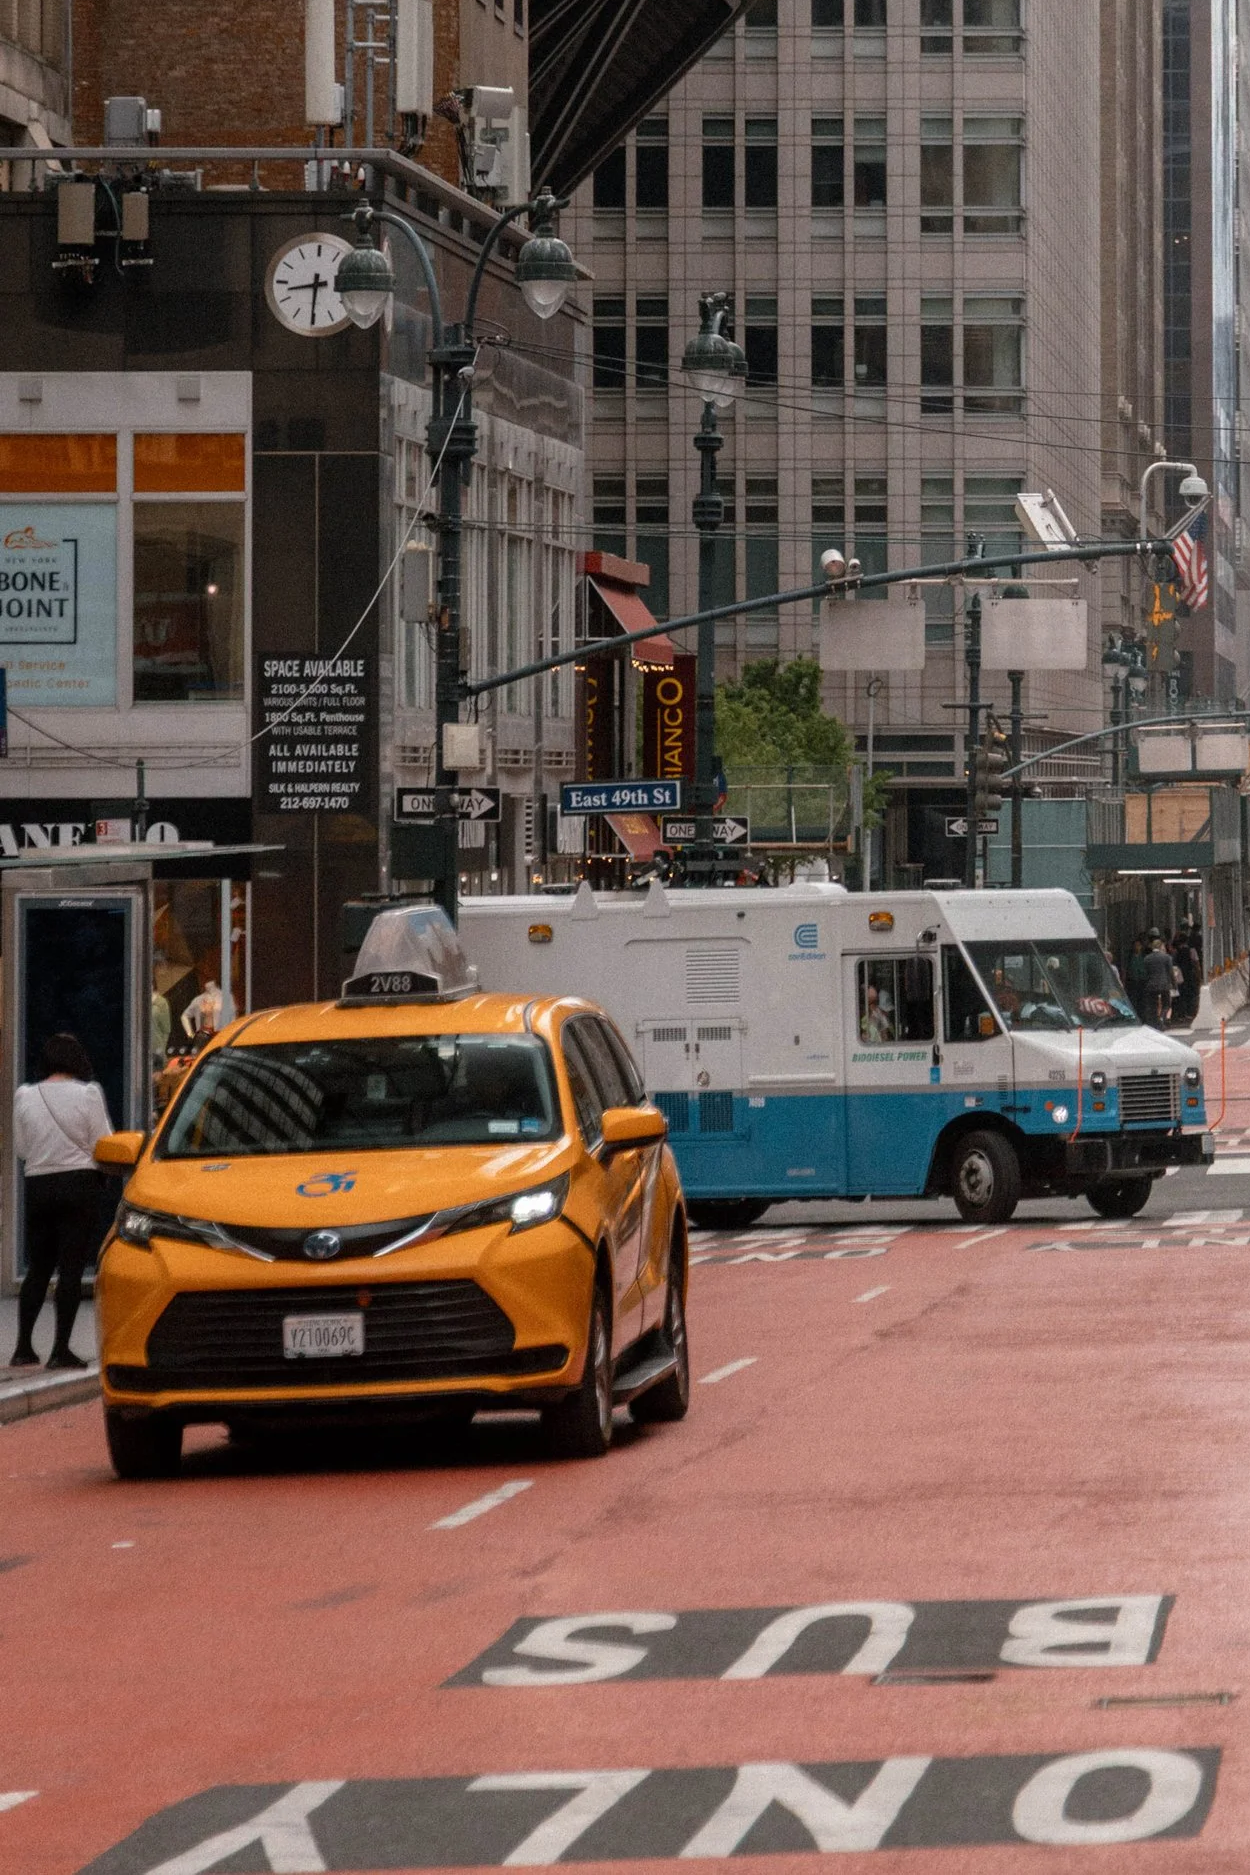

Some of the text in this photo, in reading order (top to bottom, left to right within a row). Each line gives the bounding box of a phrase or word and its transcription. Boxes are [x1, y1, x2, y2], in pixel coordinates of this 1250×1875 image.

[264, 660, 365, 677] SPACE AVAILABLE
[323, 697, 340, 705] FULL
[342, 696, 366, 705] FLOOR
[320, 712, 364, 722] Penthouse
[272, 725, 358, 736] WITH USABLE TERRACE
[656, 677, 683, 778] IANCO
[269, 744, 359, 756] ALL AVAILABLE
[272, 761, 356, 773] IMMEDIATELY
[268, 783, 360, 793] SILK & HALPERN REALTY
[280, 796, 350, 809] 212-697-1470
[570, 788, 672, 808] East 49th St
[669, 826, 695, 836] ONE
[371, 975, 411, 993] 2V88
[852, 1052, 928, 1063] BIODIESEL POWER
[291, 1326, 357, 1348] Y210069C
[481, 1595, 1164, 1686] BUS
[142, 1748, 1203, 1875] ONLY
